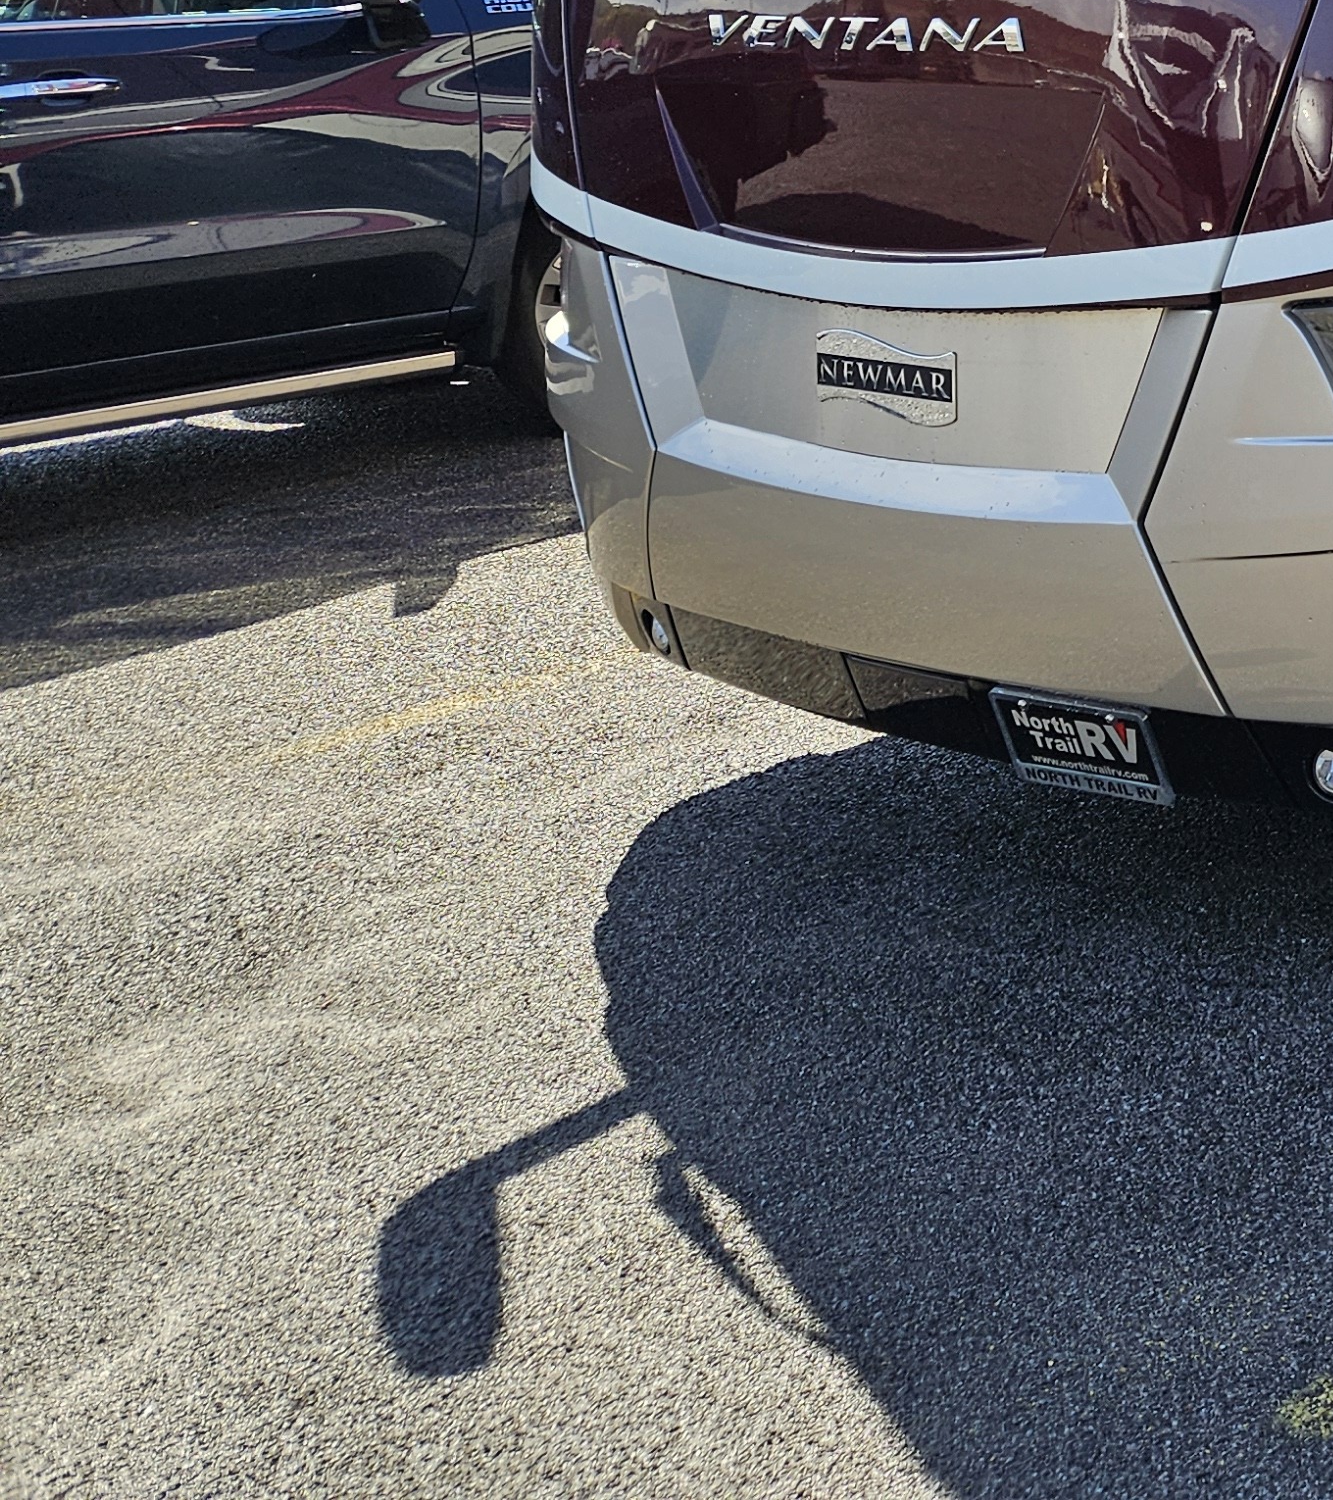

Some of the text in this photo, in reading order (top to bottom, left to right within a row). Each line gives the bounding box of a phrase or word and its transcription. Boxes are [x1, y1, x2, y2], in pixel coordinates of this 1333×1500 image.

[708, 14, 1025, 53] VENTANA
[818, 357, 951, 400] NEWMAR
[1011, 709, 1076, 736] North
[1029, 730, 1083, 755] Trail
[1074, 720, 1138, 764] RV
[1024, 767, 1158, 801] NORTH TRAIL RV
[1031, 754, 1149, 781] www.northtrailrv.com
